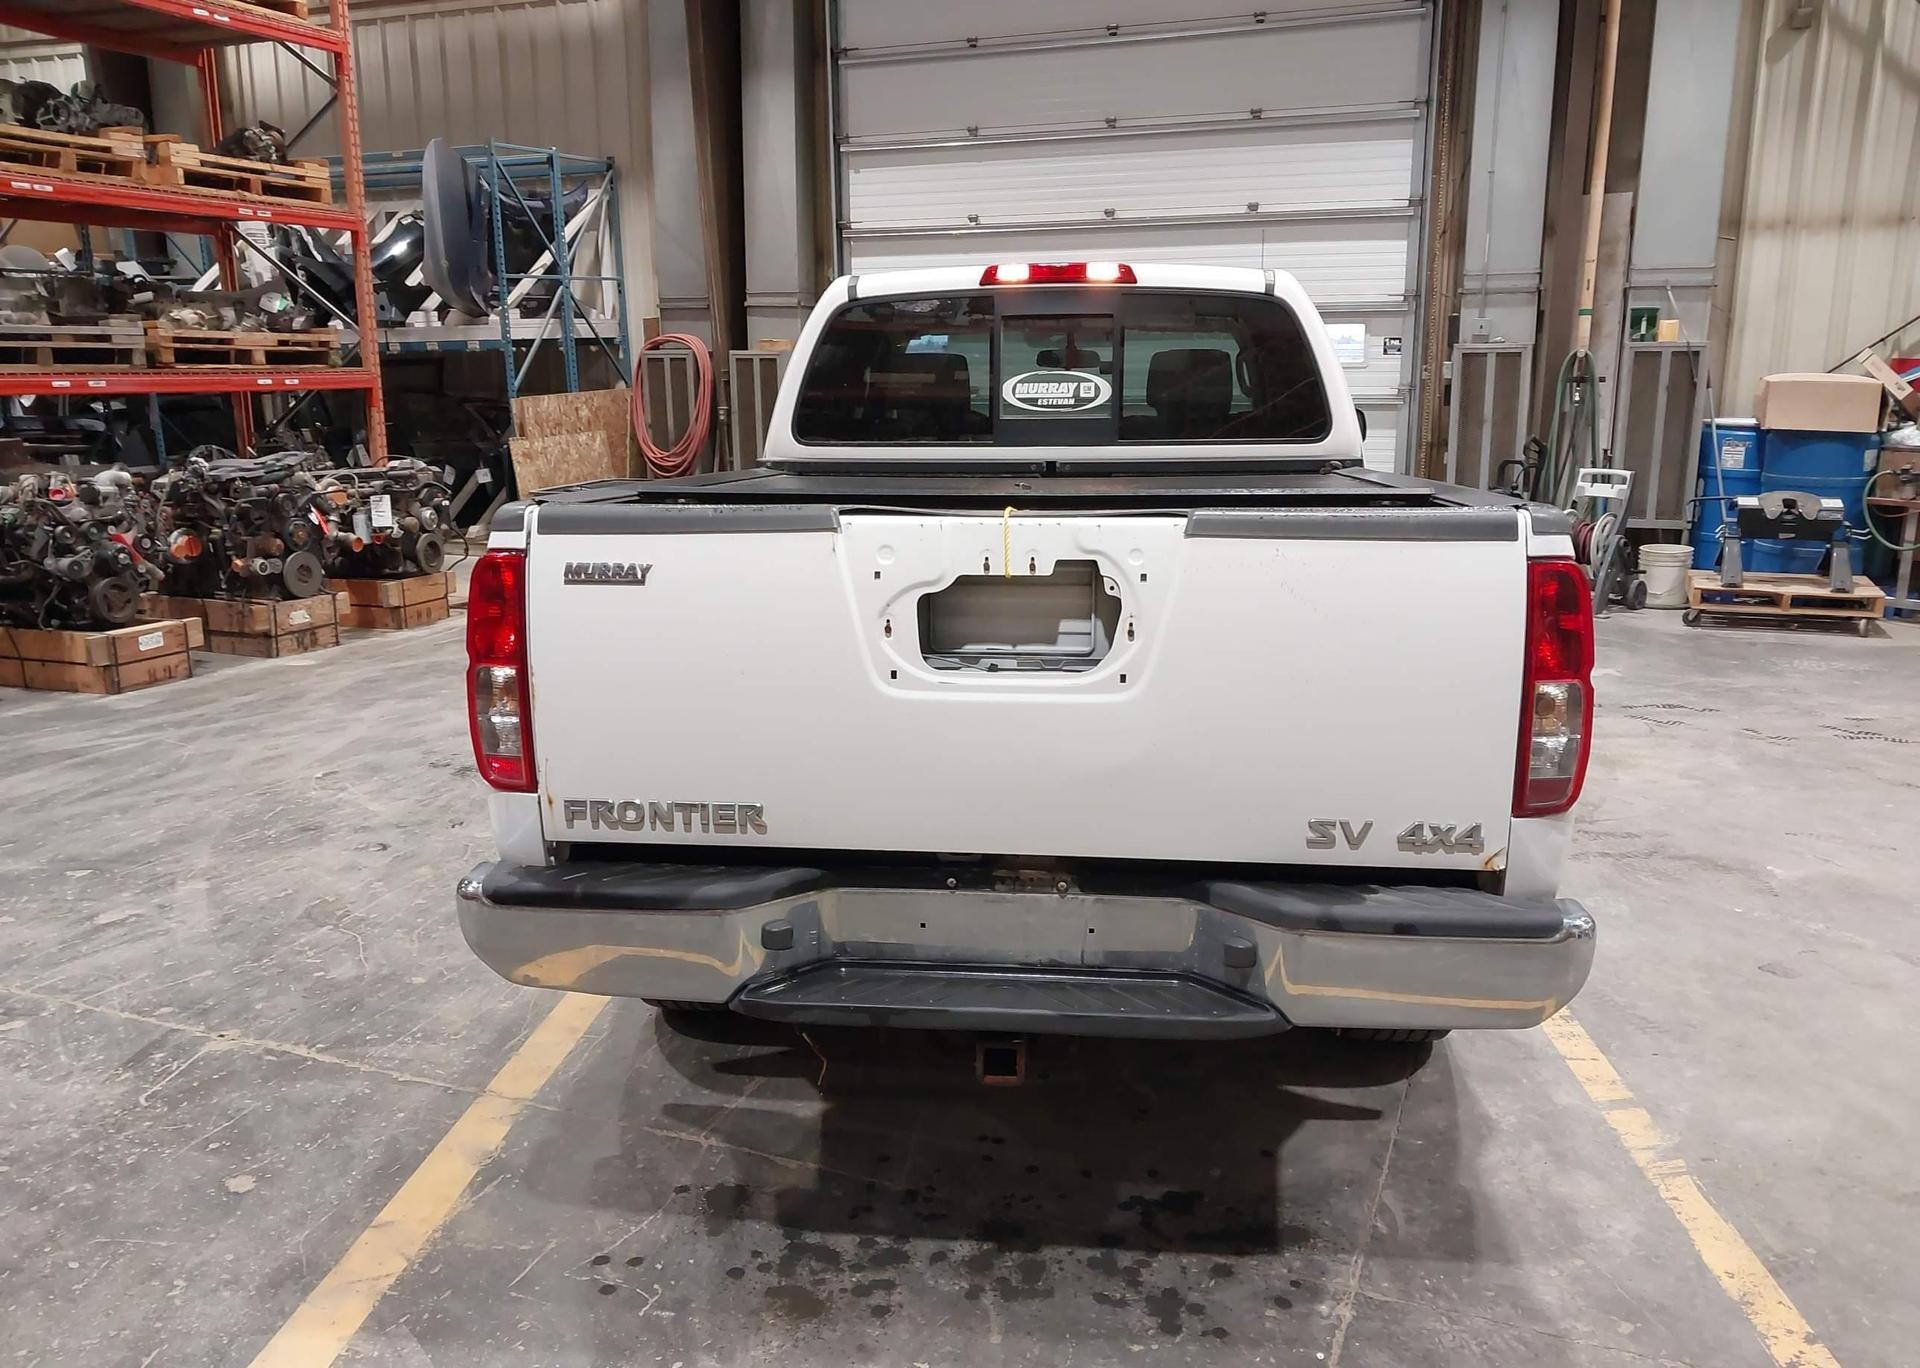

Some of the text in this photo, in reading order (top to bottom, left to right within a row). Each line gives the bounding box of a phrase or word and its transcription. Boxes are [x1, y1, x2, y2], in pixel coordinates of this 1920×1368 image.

[1015, 382, 1078, 394] MURRAY
[563, 562, 653, 580] MURRAY
[563, 799, 768, 835] FRONTIER
[1306, 818, 1374, 850] SV
